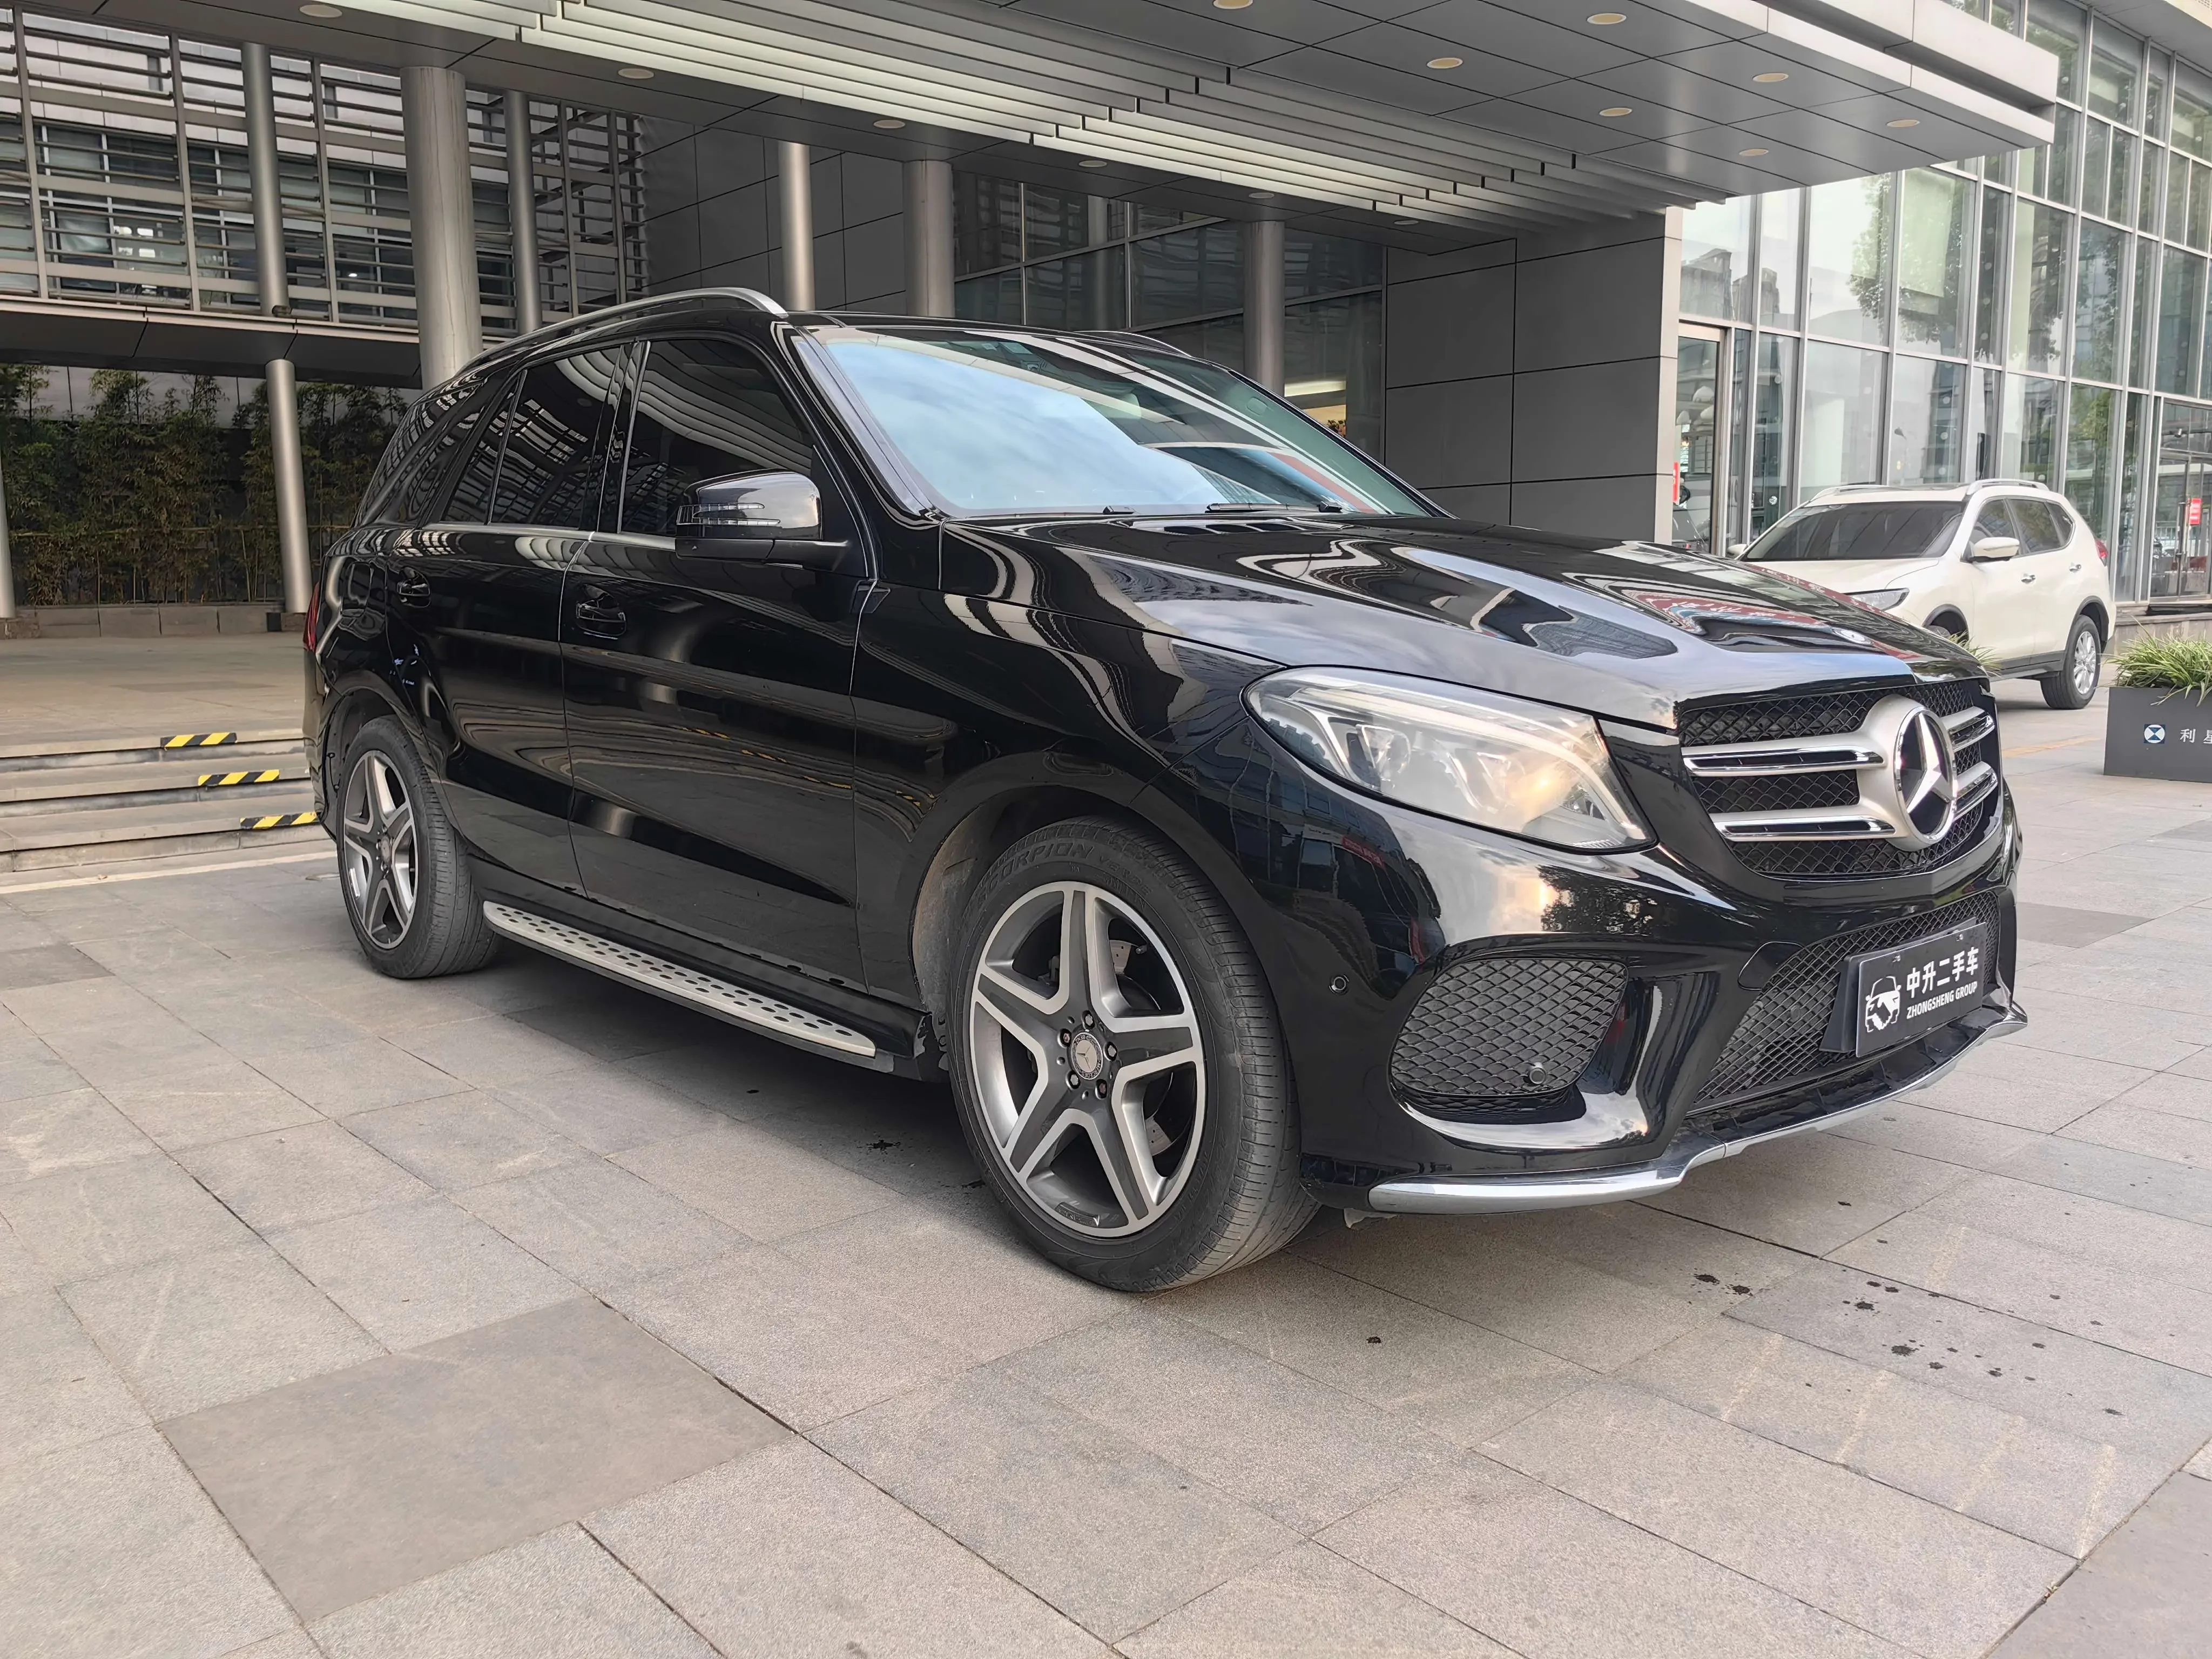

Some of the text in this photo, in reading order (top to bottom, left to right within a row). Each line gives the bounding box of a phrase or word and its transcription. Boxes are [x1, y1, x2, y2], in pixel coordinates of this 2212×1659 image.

[1907, 947, 1979, 998] 中升二手车
[1907, 981, 1978, 1019] ZHONGSHENG GROUP
